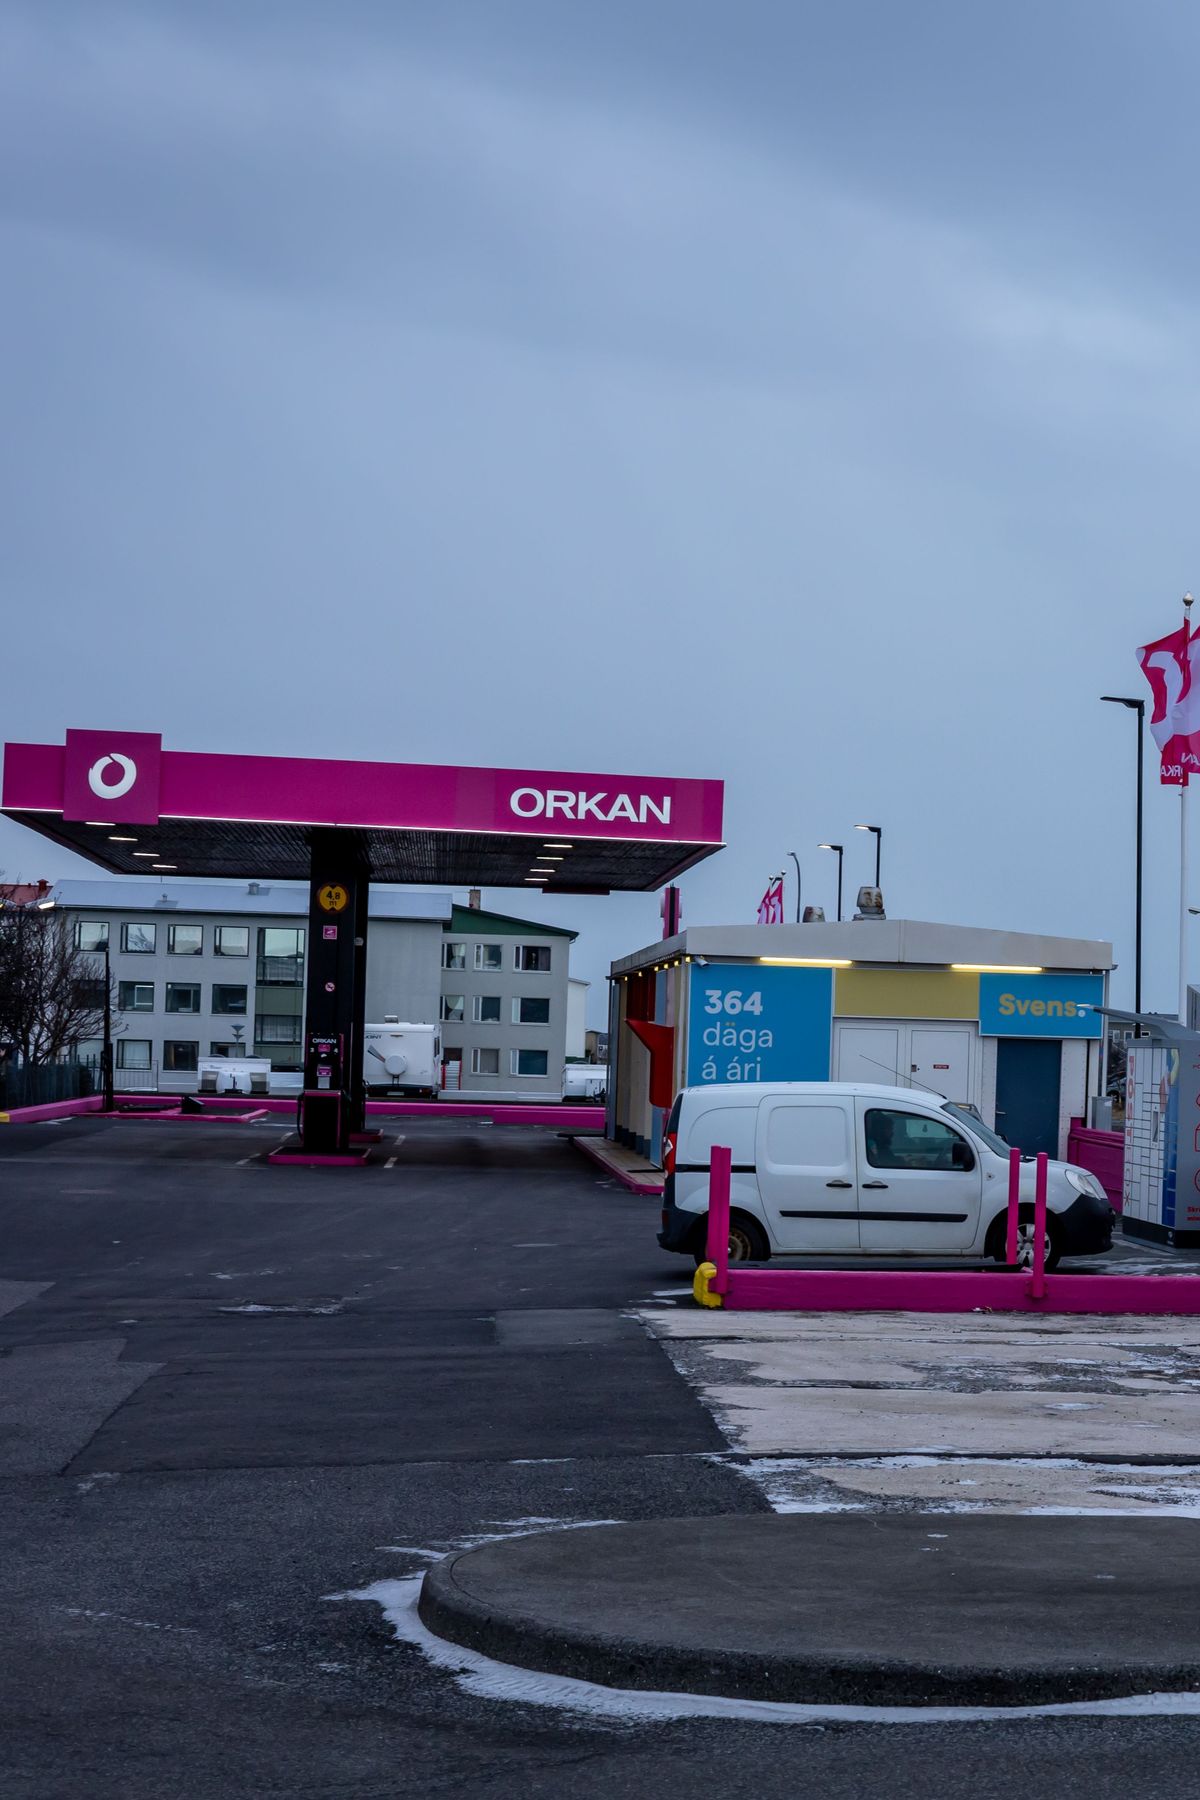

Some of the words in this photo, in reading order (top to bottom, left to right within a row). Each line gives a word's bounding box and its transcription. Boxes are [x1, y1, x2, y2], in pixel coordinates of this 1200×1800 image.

[510, 787, 672, 825] ORKAN
[704, 989, 764, 1016] 364
[701, 1055, 717, 1080] á
[726, 1055, 761, 1081] ári
